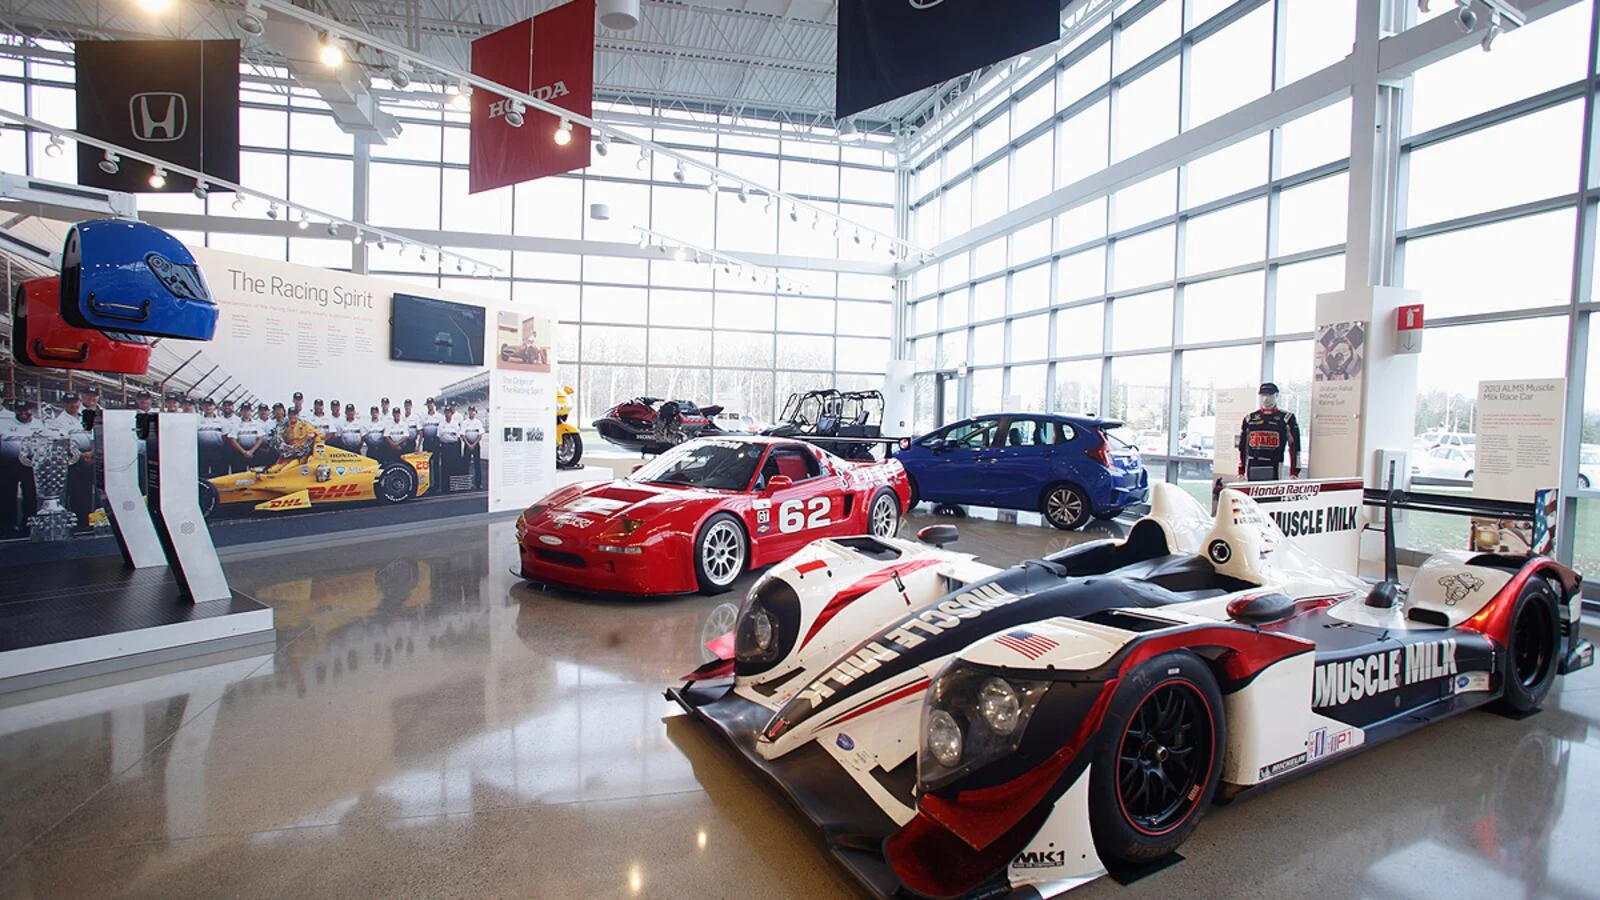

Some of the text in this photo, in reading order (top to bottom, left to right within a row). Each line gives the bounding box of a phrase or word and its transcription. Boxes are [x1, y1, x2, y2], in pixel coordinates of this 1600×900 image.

[227, 268, 373, 309] The Racing Spirit
[1502, 384, 1525, 392] ALMS
[1526, 383, 1555, 392] Muscle
[1520, 393, 1534, 401] Car
[415, 461, 428, 470] 28
[307, 484, 361, 499] DHL
[1250, 484, 1320, 497] Honda Racing
[270, 498, 302, 508] DHL
[778, 496, 831, 534] 62
[1269, 509, 1323, 537] MUSCLE
[1326, 506, 1357, 532] MILK
[797, 582, 1021, 709] MUSCLE MILK
[1312, 638, 1457, 708] MUSCLE MILK
[1014, 850, 1065, 863] MK1
